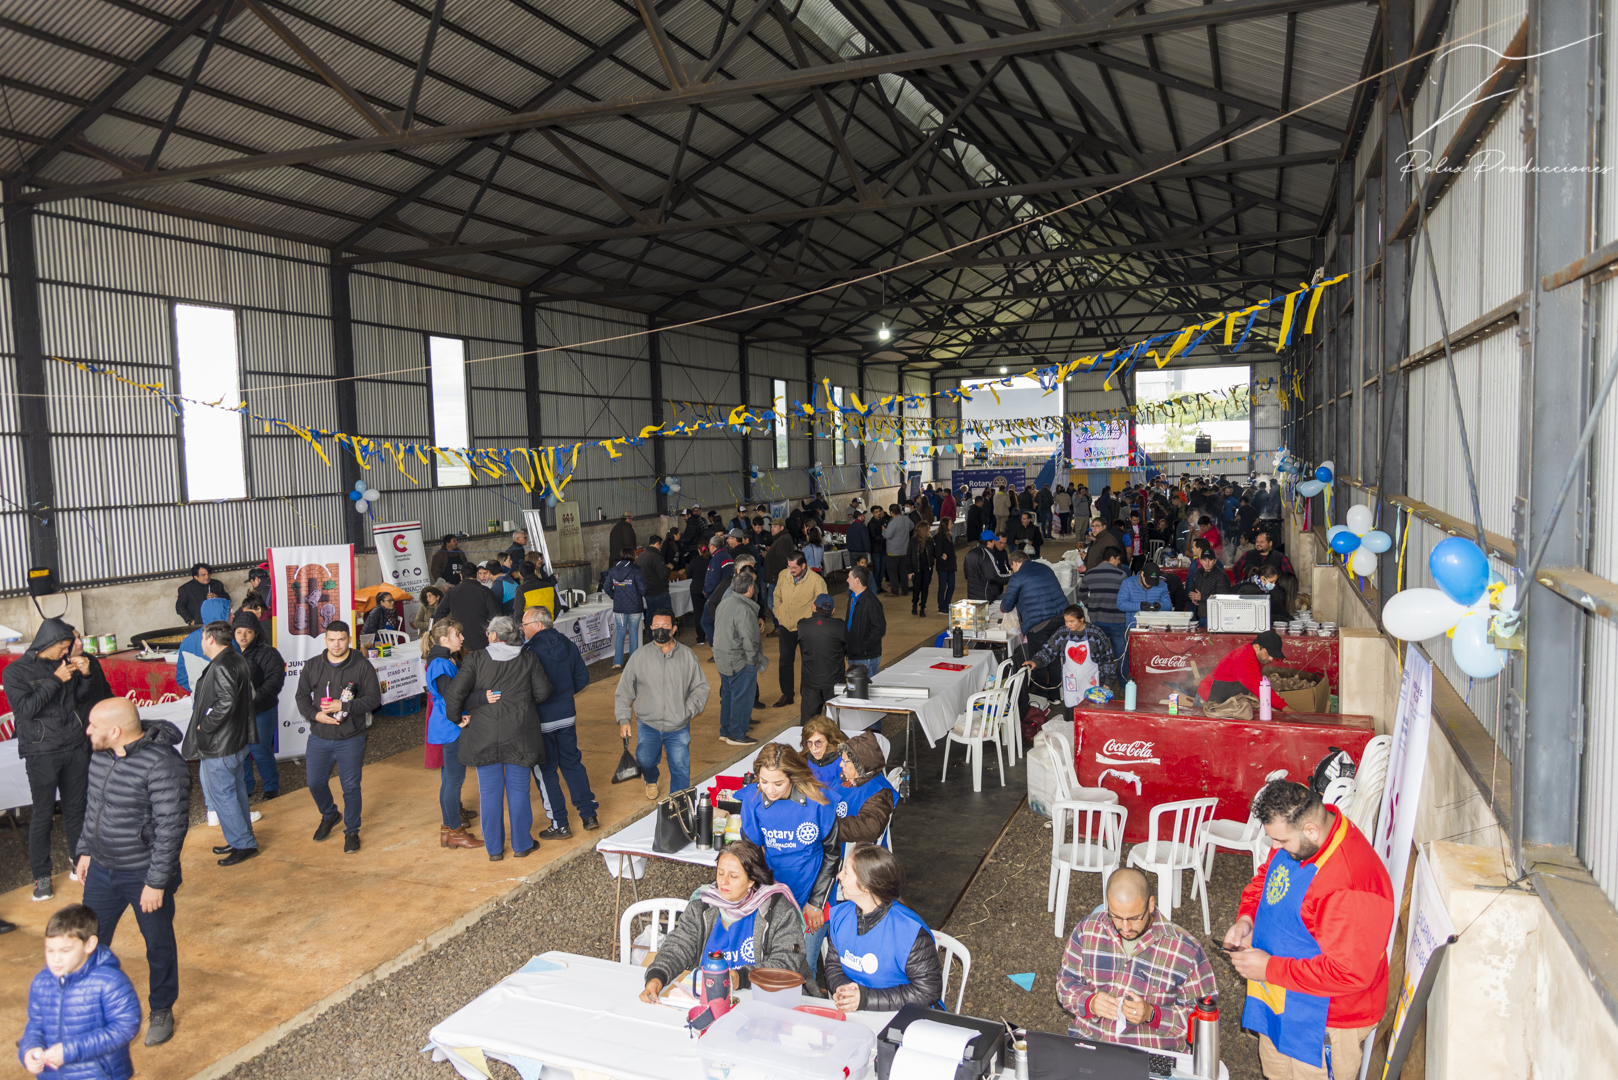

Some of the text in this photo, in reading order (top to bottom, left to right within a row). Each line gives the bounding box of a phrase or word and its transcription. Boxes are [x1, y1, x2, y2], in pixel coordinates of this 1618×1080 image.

[288, 660, 306, 668] JUNT
[1151, 655, 1192, 668] Coca-Cola
[387, 669, 401, 677] STAND
[1103, 739, 1155, 757] Coca-Cola
[761, 827, 794, 841] Rotary
